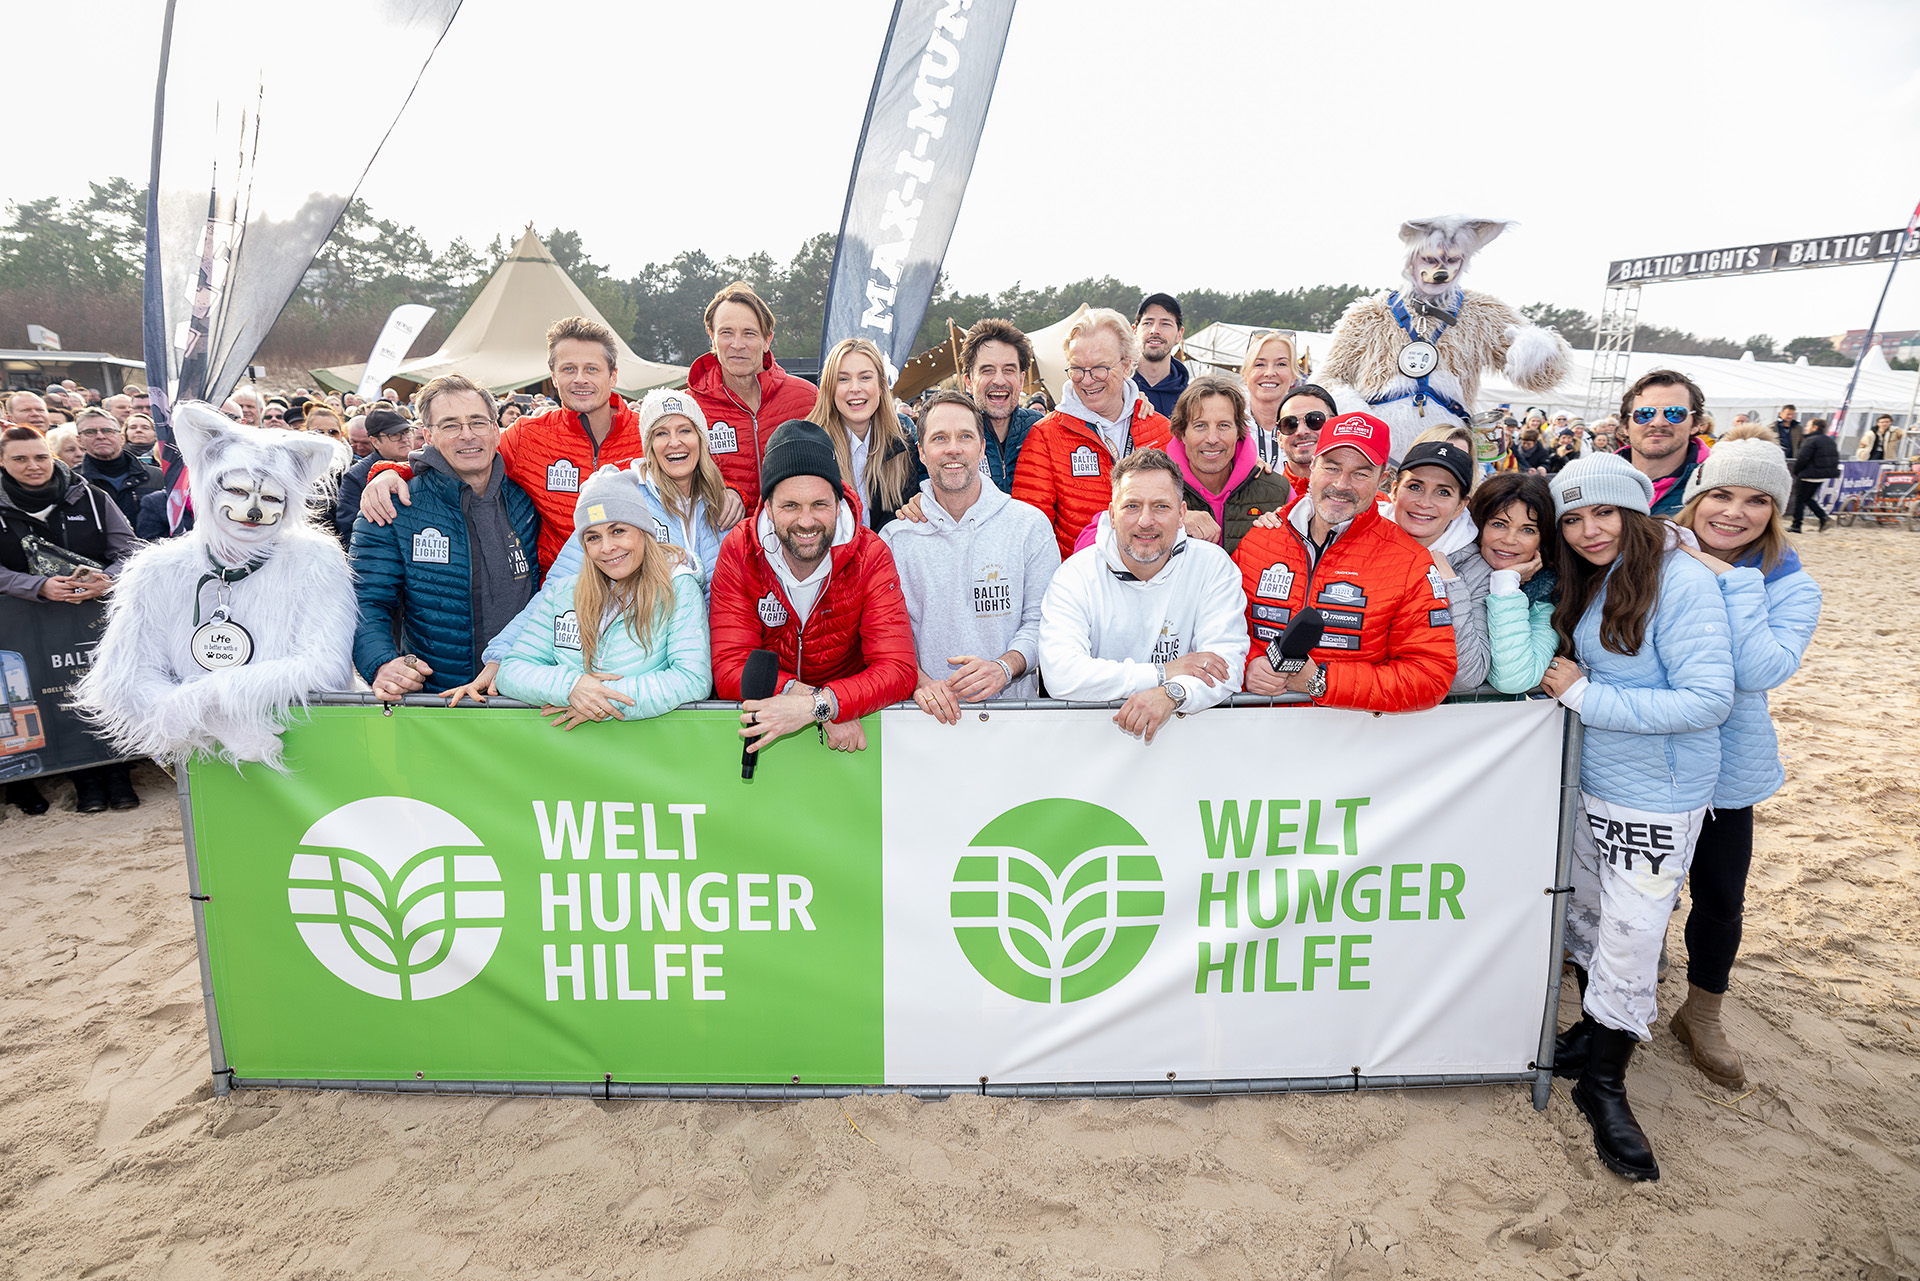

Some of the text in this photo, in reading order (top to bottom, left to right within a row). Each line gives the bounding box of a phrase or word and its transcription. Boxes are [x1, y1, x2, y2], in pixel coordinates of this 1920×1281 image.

[1788, 230, 1920, 263] BALTIC LIG
[1619, 247, 1760, 280] BALTIC LIGHTS
[709, 431, 735, 441] BALTIC
[710, 440, 735, 449] LIGHTS
[1073, 455, 1097, 463] BALTIC
[549, 468, 577, 479] BALTIC
[548, 478, 576, 487] LIGHTS
[415, 538, 448, 549] BALTIC
[414, 548, 447, 559] LIGHTS
[1262, 572, 1291, 583] BALTIC
[974, 585, 1010, 599] BALTIC
[1259, 581, 1288, 594] LIGHTS
[975, 598, 1011, 612] LIGHTS
[556, 621, 580, 634] BALTI
[1153, 638, 1180, 654] ALTIC
[51, 650, 94, 668] BALT
[215, 652, 234, 661] DOG
[1150, 650, 1179, 664] IGHTS
[532, 800, 707, 860] WELT
[1198, 797, 1371, 859] WELT
[1587, 813, 1675, 850] FREE
[540, 872, 817, 932] HUNGER
[1198, 863, 1466, 929] HUNGER
[1195, 934, 1372, 993] HILFE
[543, 944, 726, 1001] HILFE
